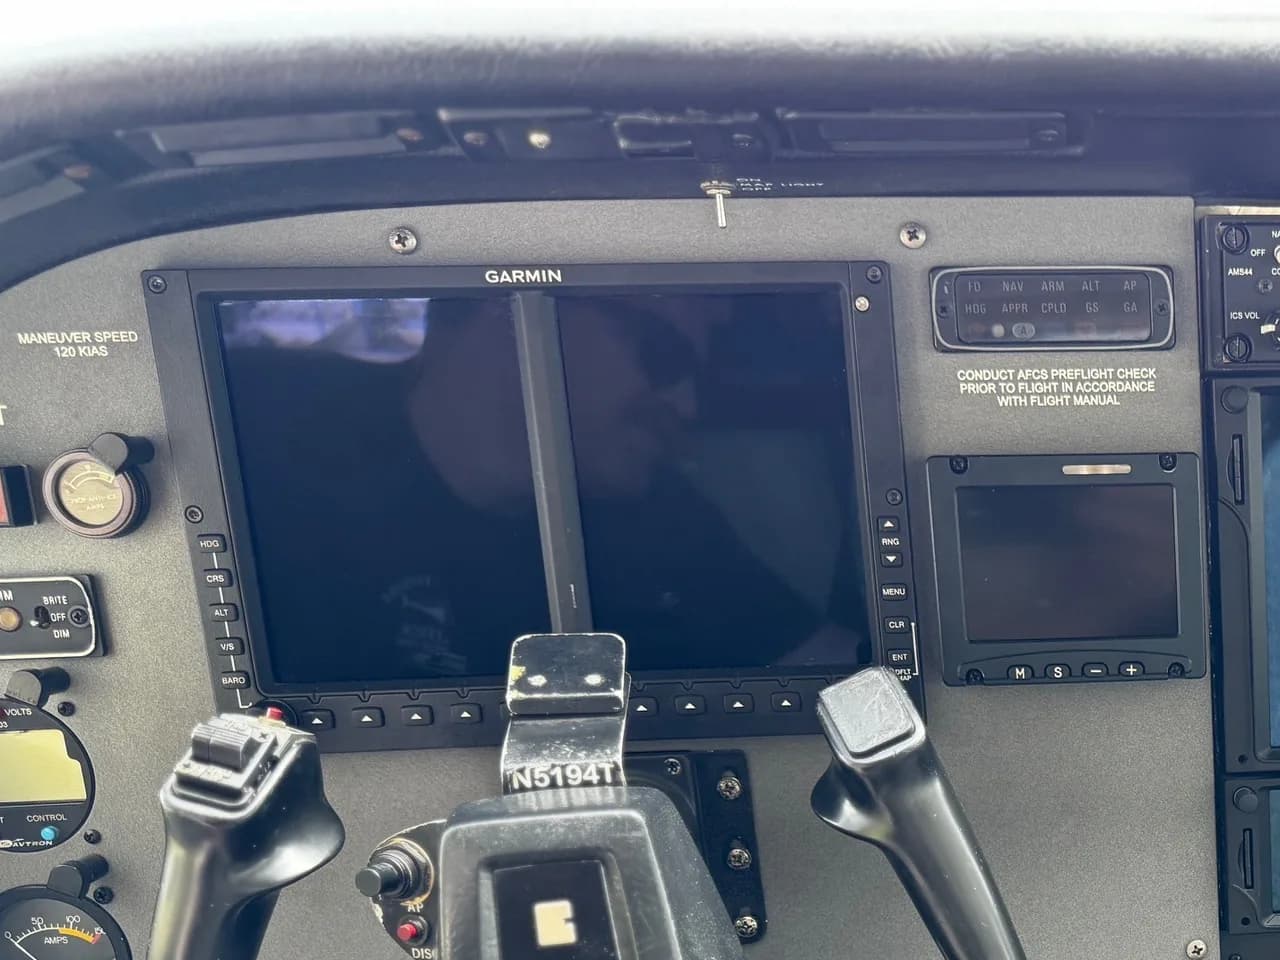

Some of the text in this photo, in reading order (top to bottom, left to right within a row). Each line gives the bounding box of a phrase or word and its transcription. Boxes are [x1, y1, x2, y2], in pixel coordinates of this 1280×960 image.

[485, 269, 562, 283] GARMIN
[18, 330, 138, 346] MANEUVER SPEED
[54, 344, 108, 358] 120 KIAS
[957, 367, 1156, 381] CONDUCT AFCS PREFLIGHT CHECK
[960, 380, 1155, 394] PRIOR TO FLIGHT IN ACCORDANCE
[997, 394, 1120, 407] WITH FLIGHT MANUAL
[200, 539, 220, 549] HDG
[881, 537, 900, 547] RNG
[206, 574, 224, 584] CRS
[882, 587, 906, 597] MENU
[42, 596, 68, 606] BRITE
[50, 612, 66, 622] OFF
[214, 608, 229, 617] ALT
[888, 620, 905, 629] CLR
[53, 629, 70, 639] DIM
[892, 652, 908, 661] ENT
[222, 676, 246, 686] BARO
[511, 764, 615, 788] N5194T
[26, 814, 67, 822] CONTROL
[44, 936, 68, 946] AMPS
